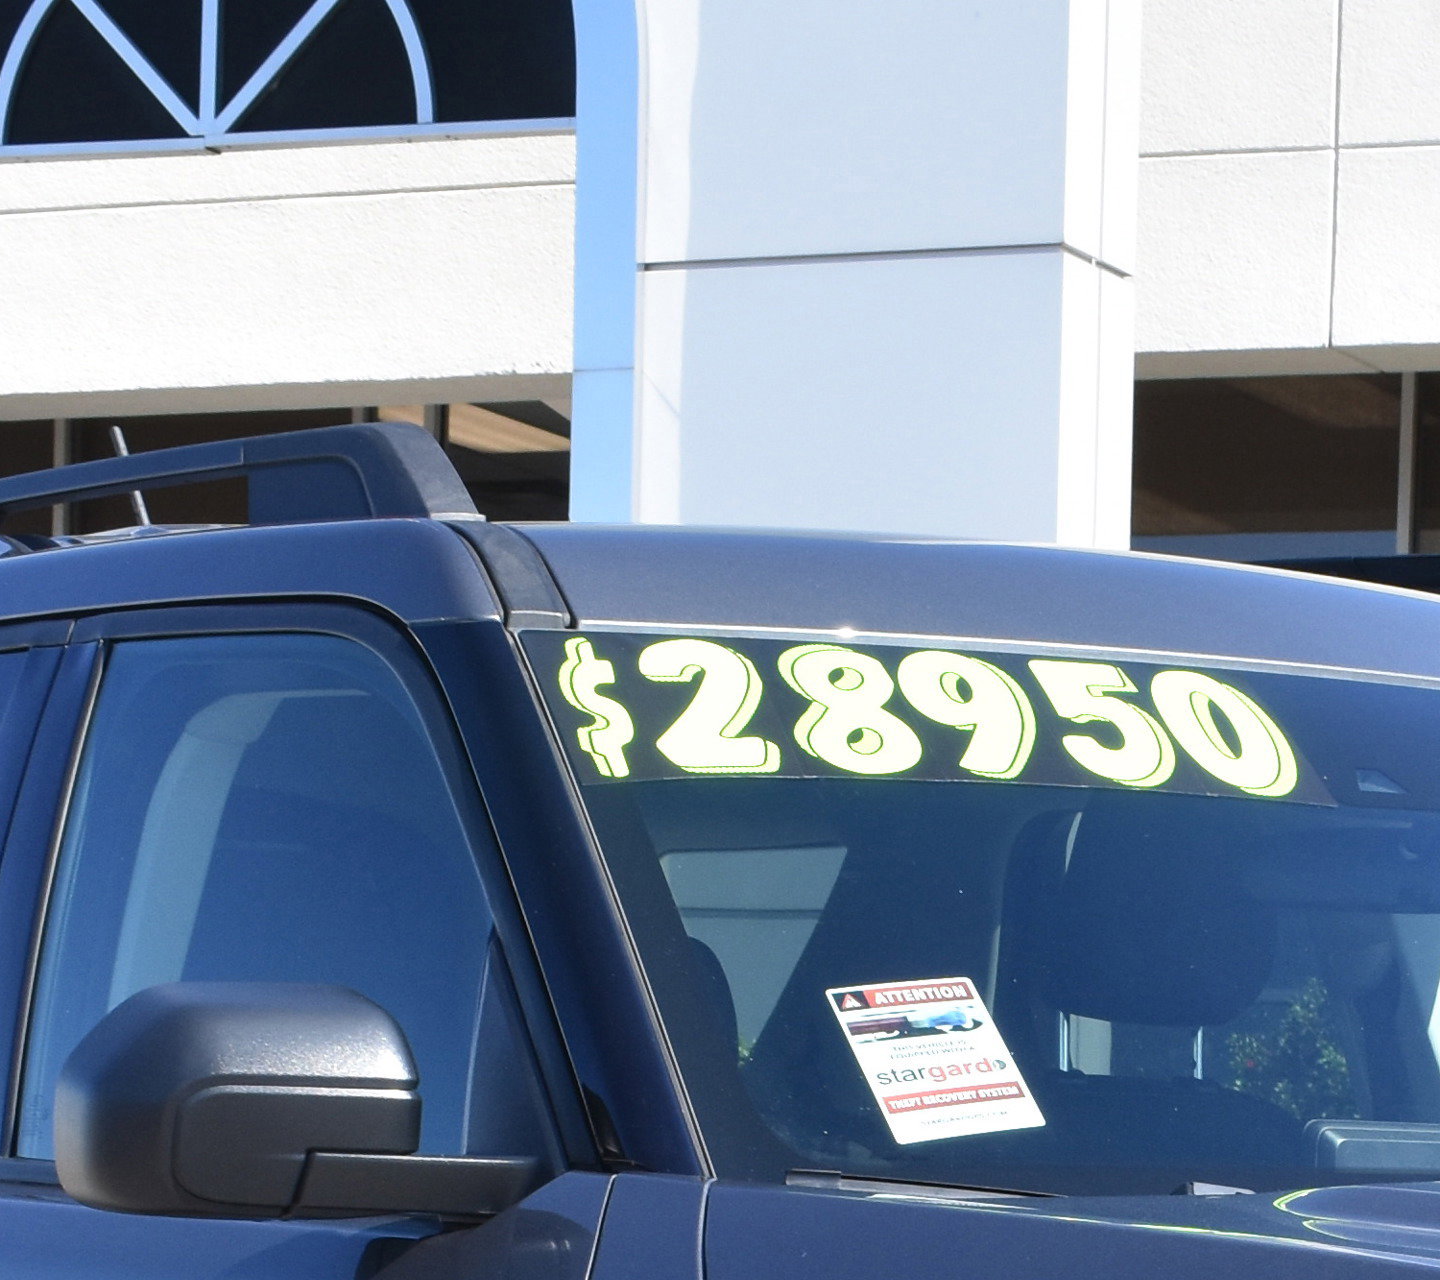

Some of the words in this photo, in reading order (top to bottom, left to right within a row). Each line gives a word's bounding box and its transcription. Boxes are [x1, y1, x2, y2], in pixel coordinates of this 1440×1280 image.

[558, 636, 1299, 798] $28950
[874, 984, 969, 1005] ATTENTION
[877, 1057, 993, 1085] stargard
